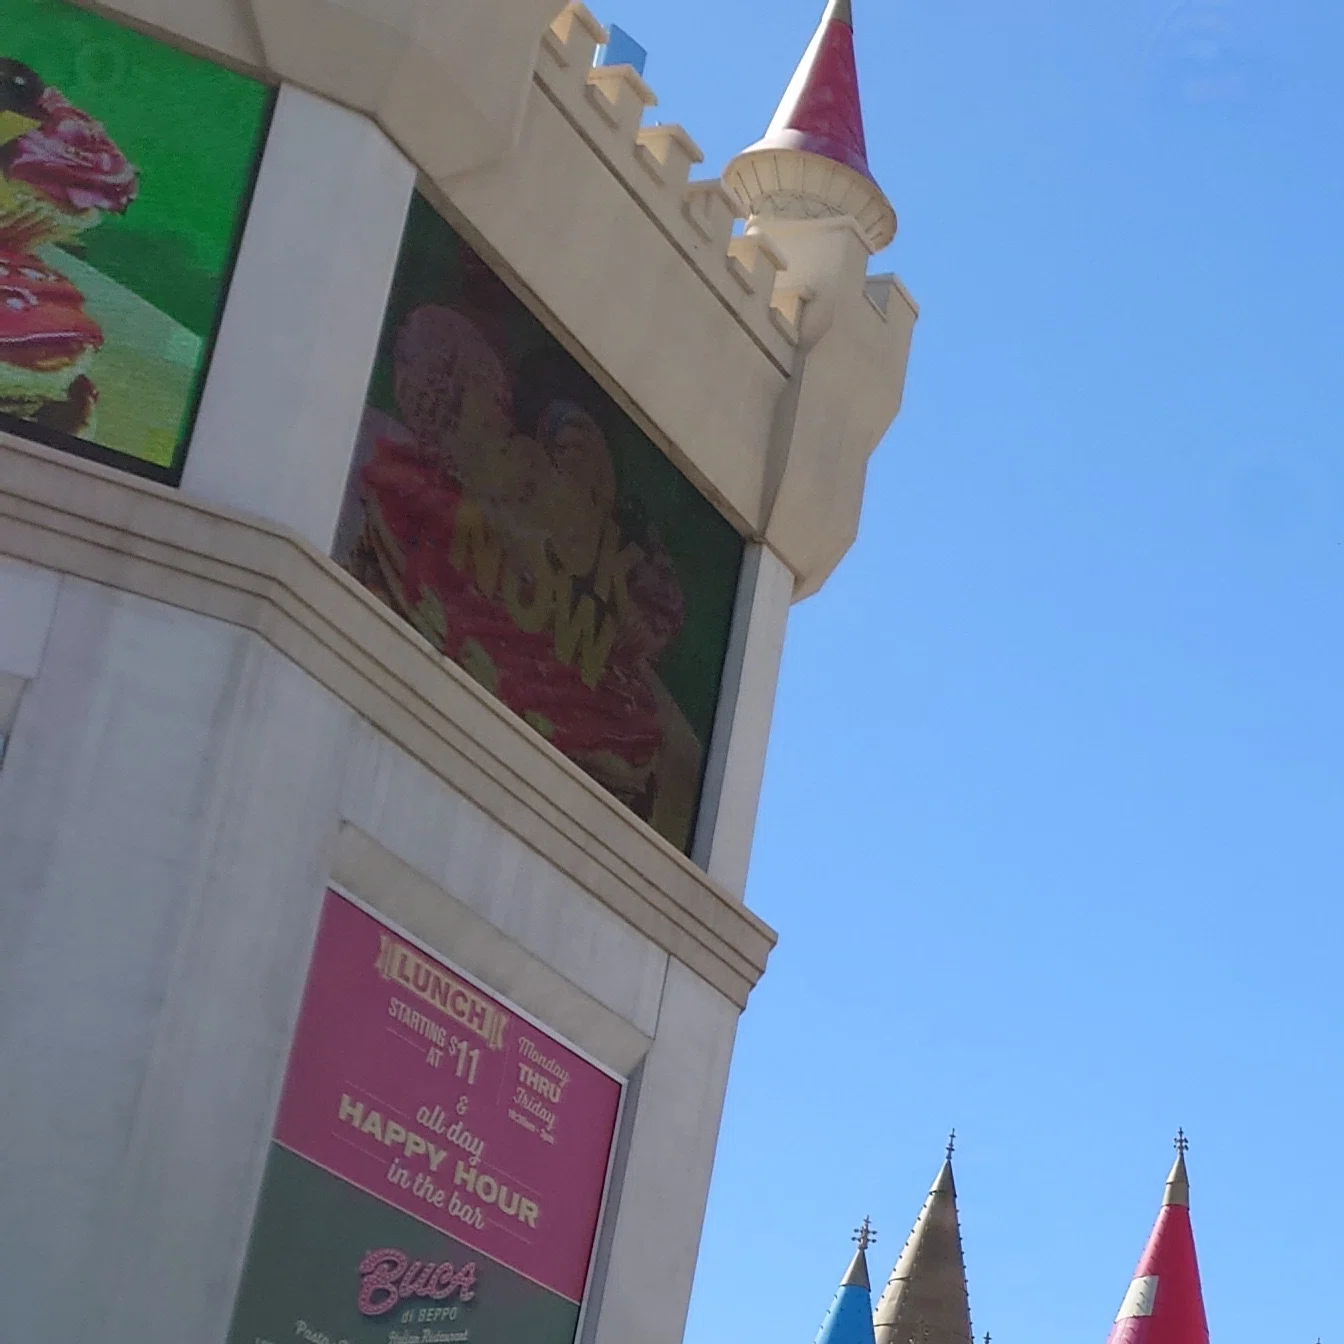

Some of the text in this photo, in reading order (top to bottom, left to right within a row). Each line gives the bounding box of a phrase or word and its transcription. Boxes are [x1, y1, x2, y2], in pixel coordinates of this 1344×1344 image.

[398, 952, 489, 1032] LUNCH
[388, 997, 447, 1047] STARTING
[426, 1047, 444, 1068] AT
[449, 1035, 480, 1085] $11
[518, 1062, 561, 1103] THRU
[519, 1036, 568, 1087] Monday
[456, 1095, 469, 1116] &
[513, 1087, 555, 1130] Friday
[416, 1104, 485, 1165] all day
[338, 1093, 539, 1228] HAPPY HOUR
[387, 1157, 485, 1230] in the bar
[418, 1307, 458, 1322] BEPPO
